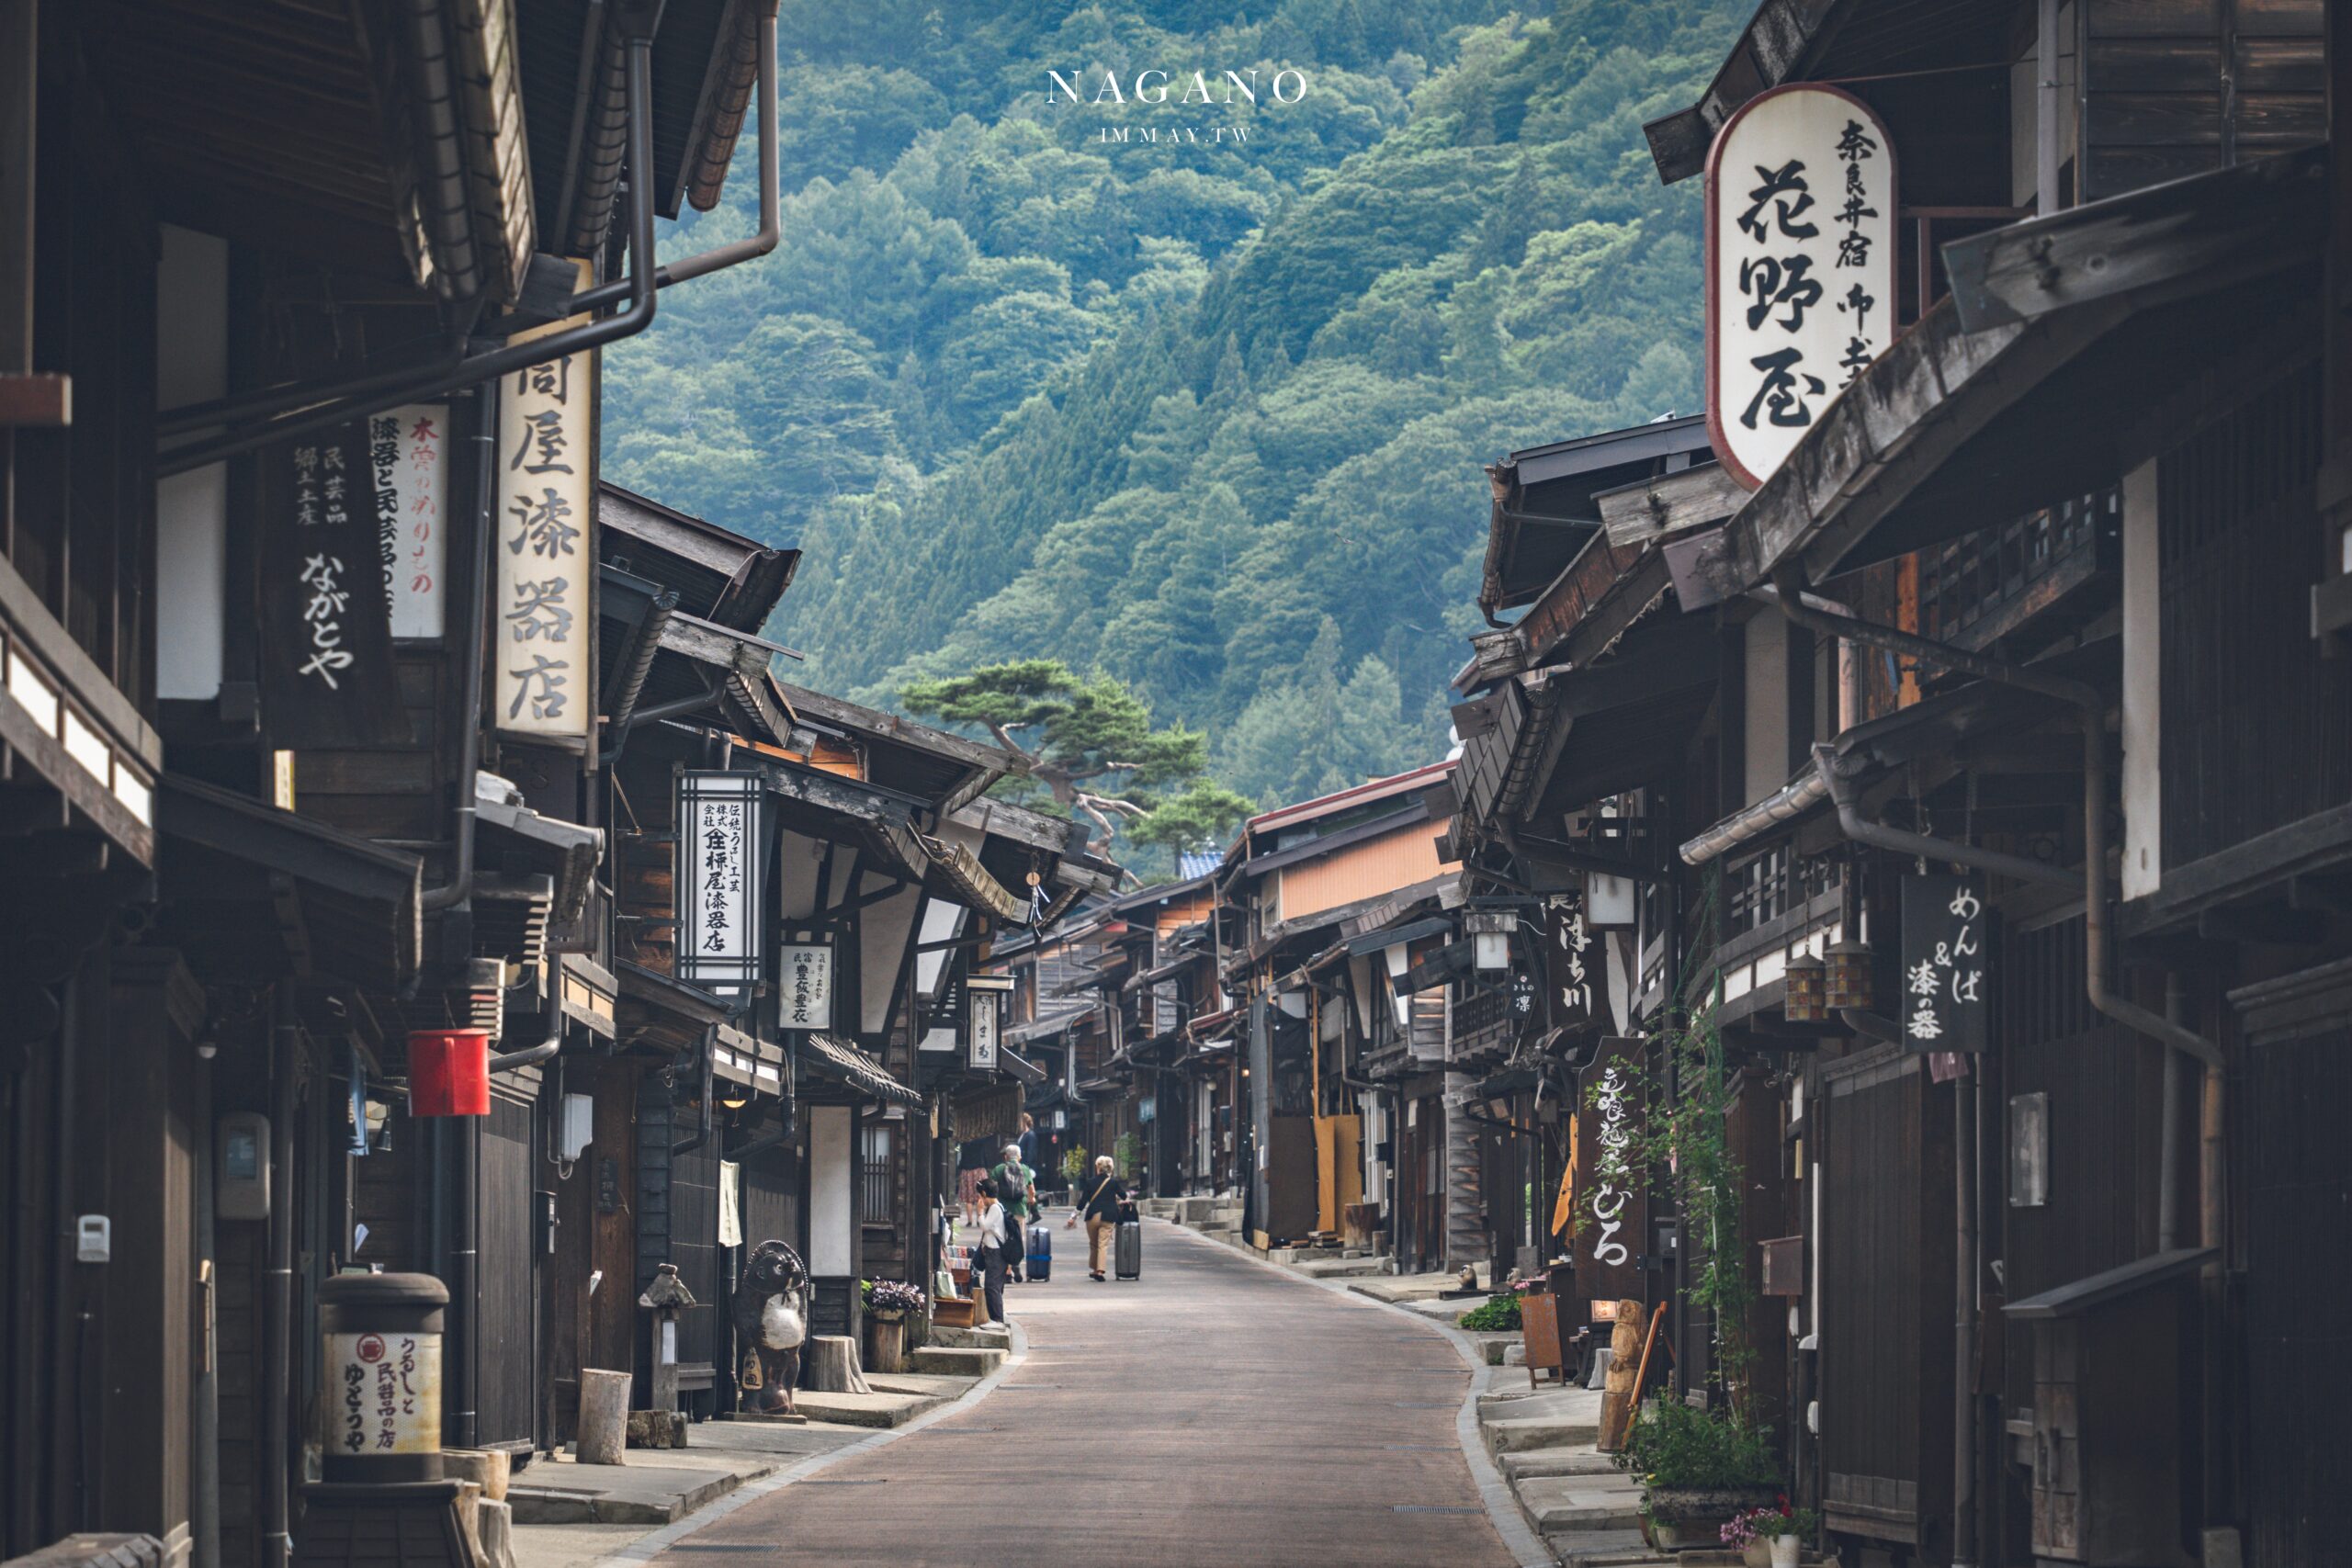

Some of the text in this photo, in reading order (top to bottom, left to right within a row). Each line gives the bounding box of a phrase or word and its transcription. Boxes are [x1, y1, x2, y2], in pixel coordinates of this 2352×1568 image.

[1737, 160, 1826, 429] 花野屋
[324, 446, 347, 524] 民芸品
[299, 553, 354, 690] ながとや
[1949, 885, 1982, 1004] めんぱ
[345, 1363, 365, 1452] ゆとうや
[399, 1337, 416, 1415] うるしと
